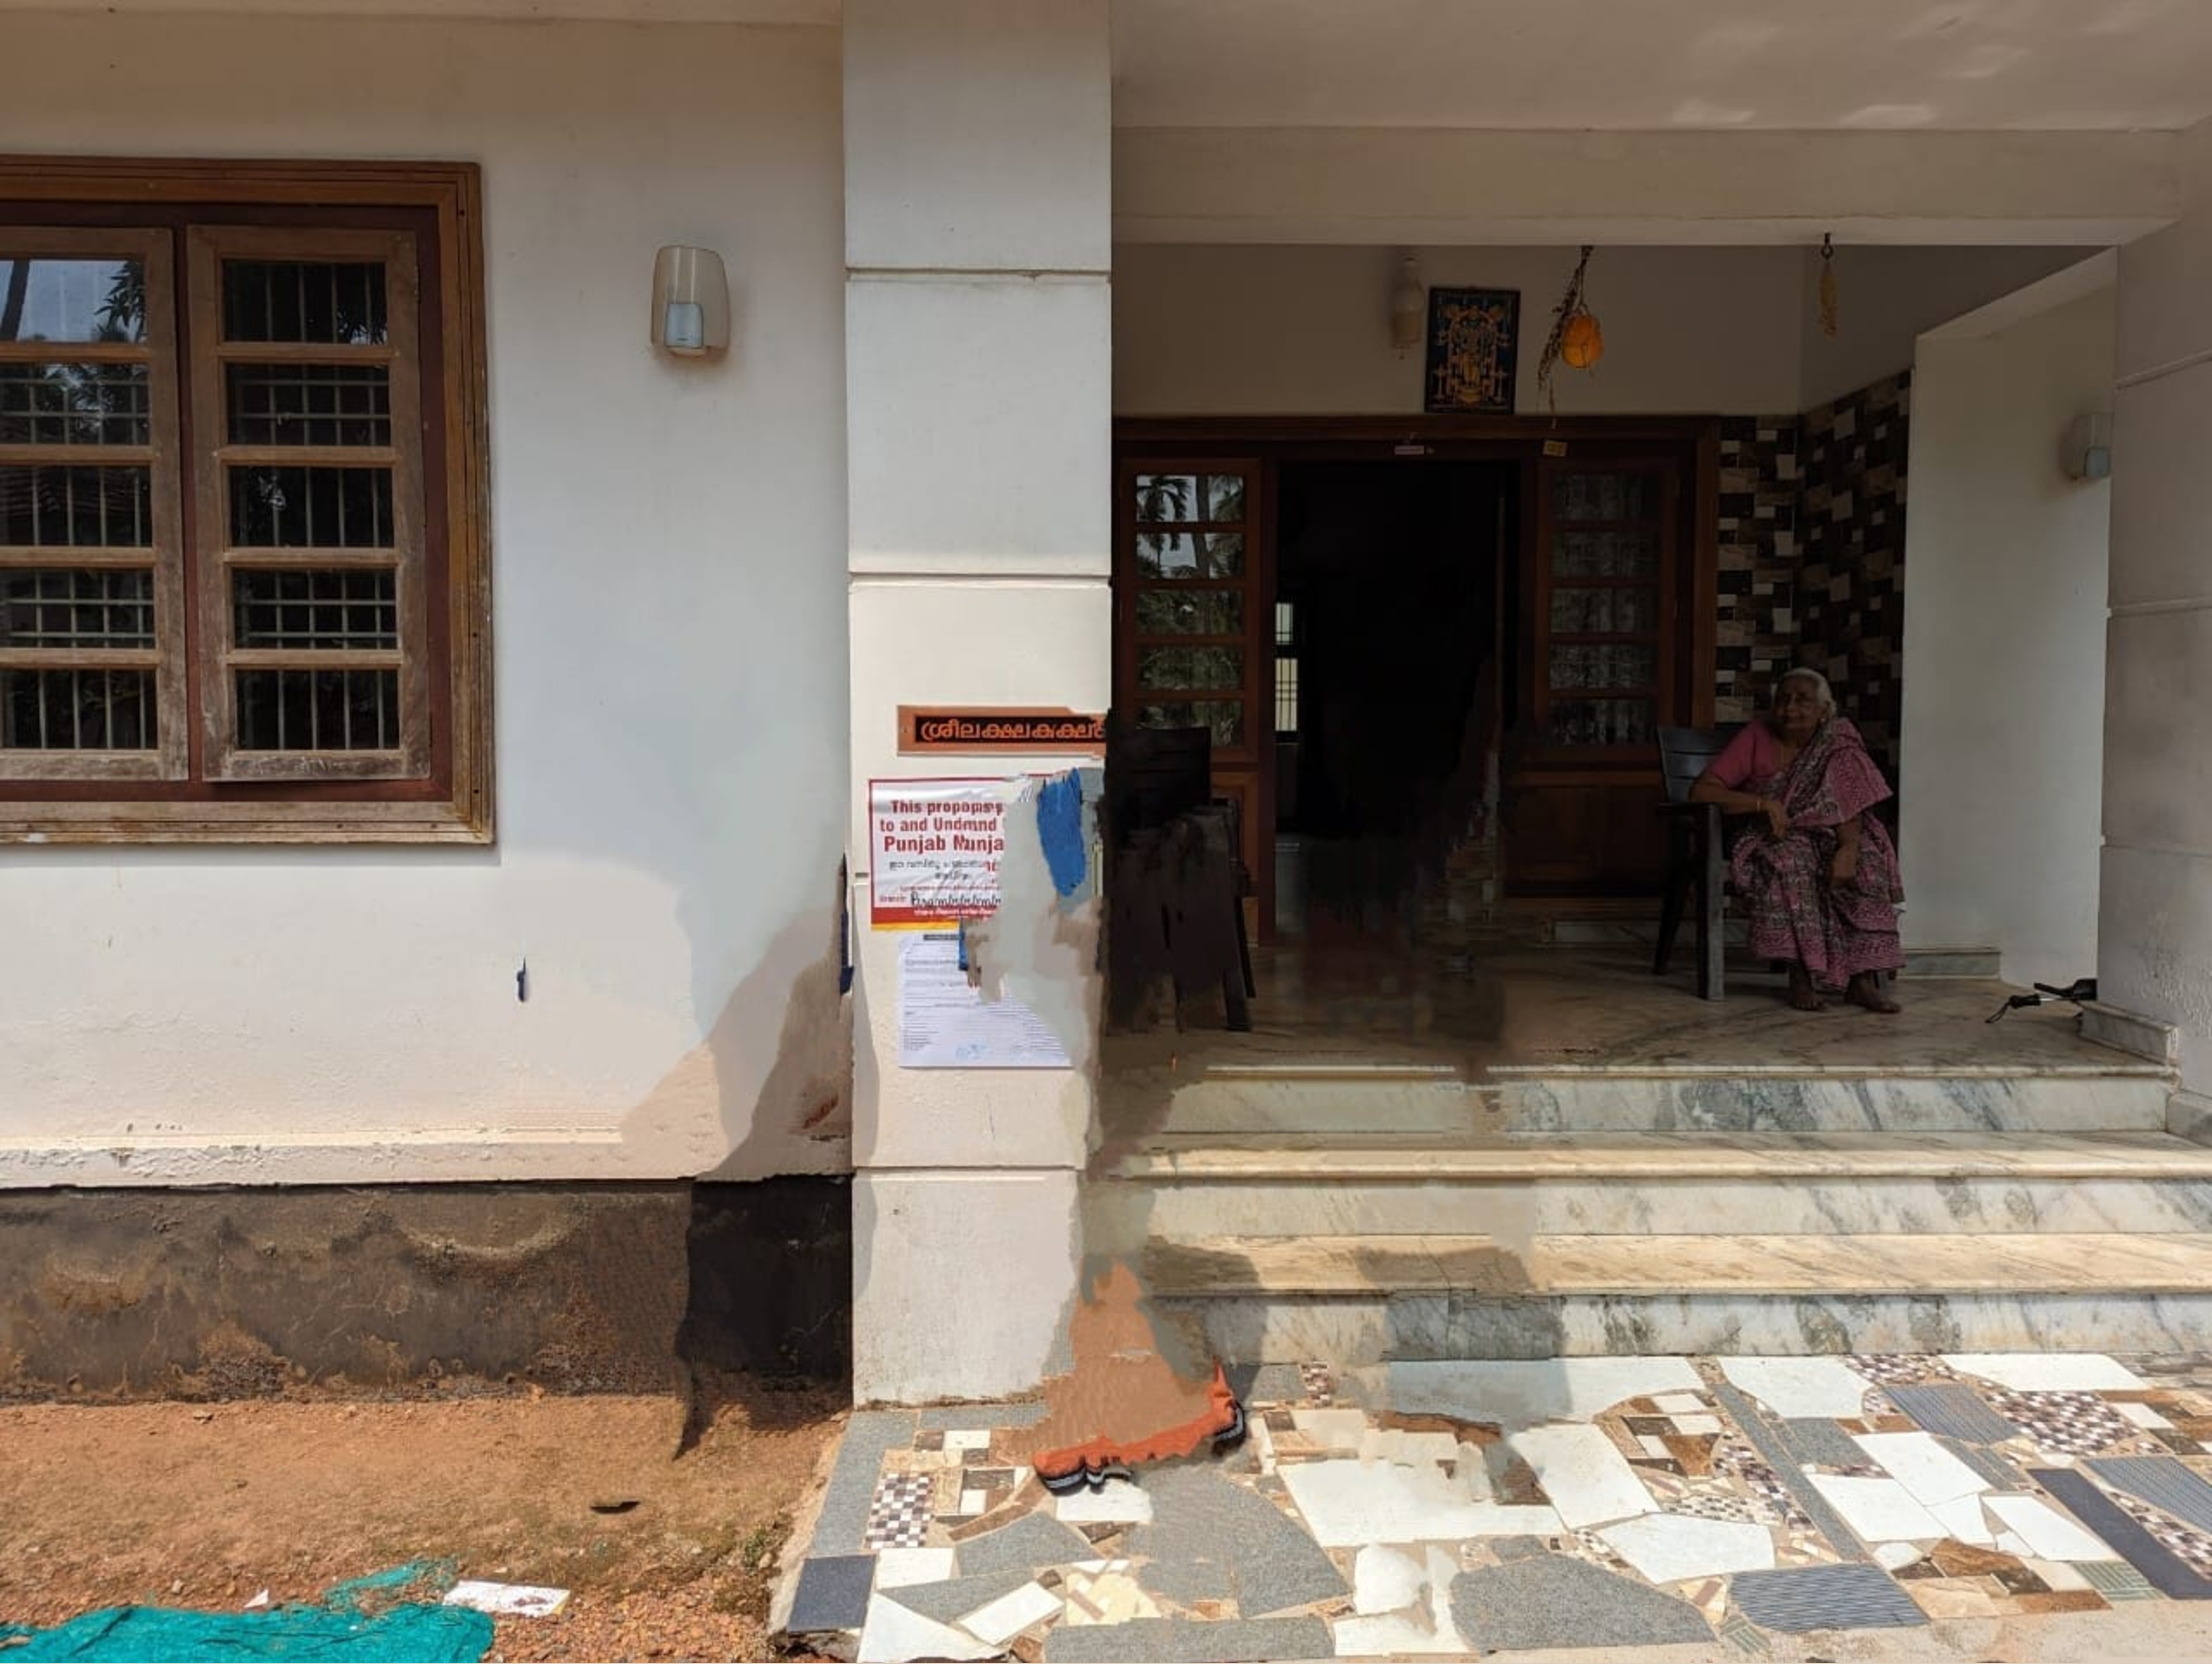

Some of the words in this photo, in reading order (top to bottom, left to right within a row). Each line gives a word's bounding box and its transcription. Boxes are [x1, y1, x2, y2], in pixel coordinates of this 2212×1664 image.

[891, 800, 922, 814] This
[880, 819, 894, 832] to
[900, 818, 928, 832] and
[884, 835, 946, 855] Punjab
